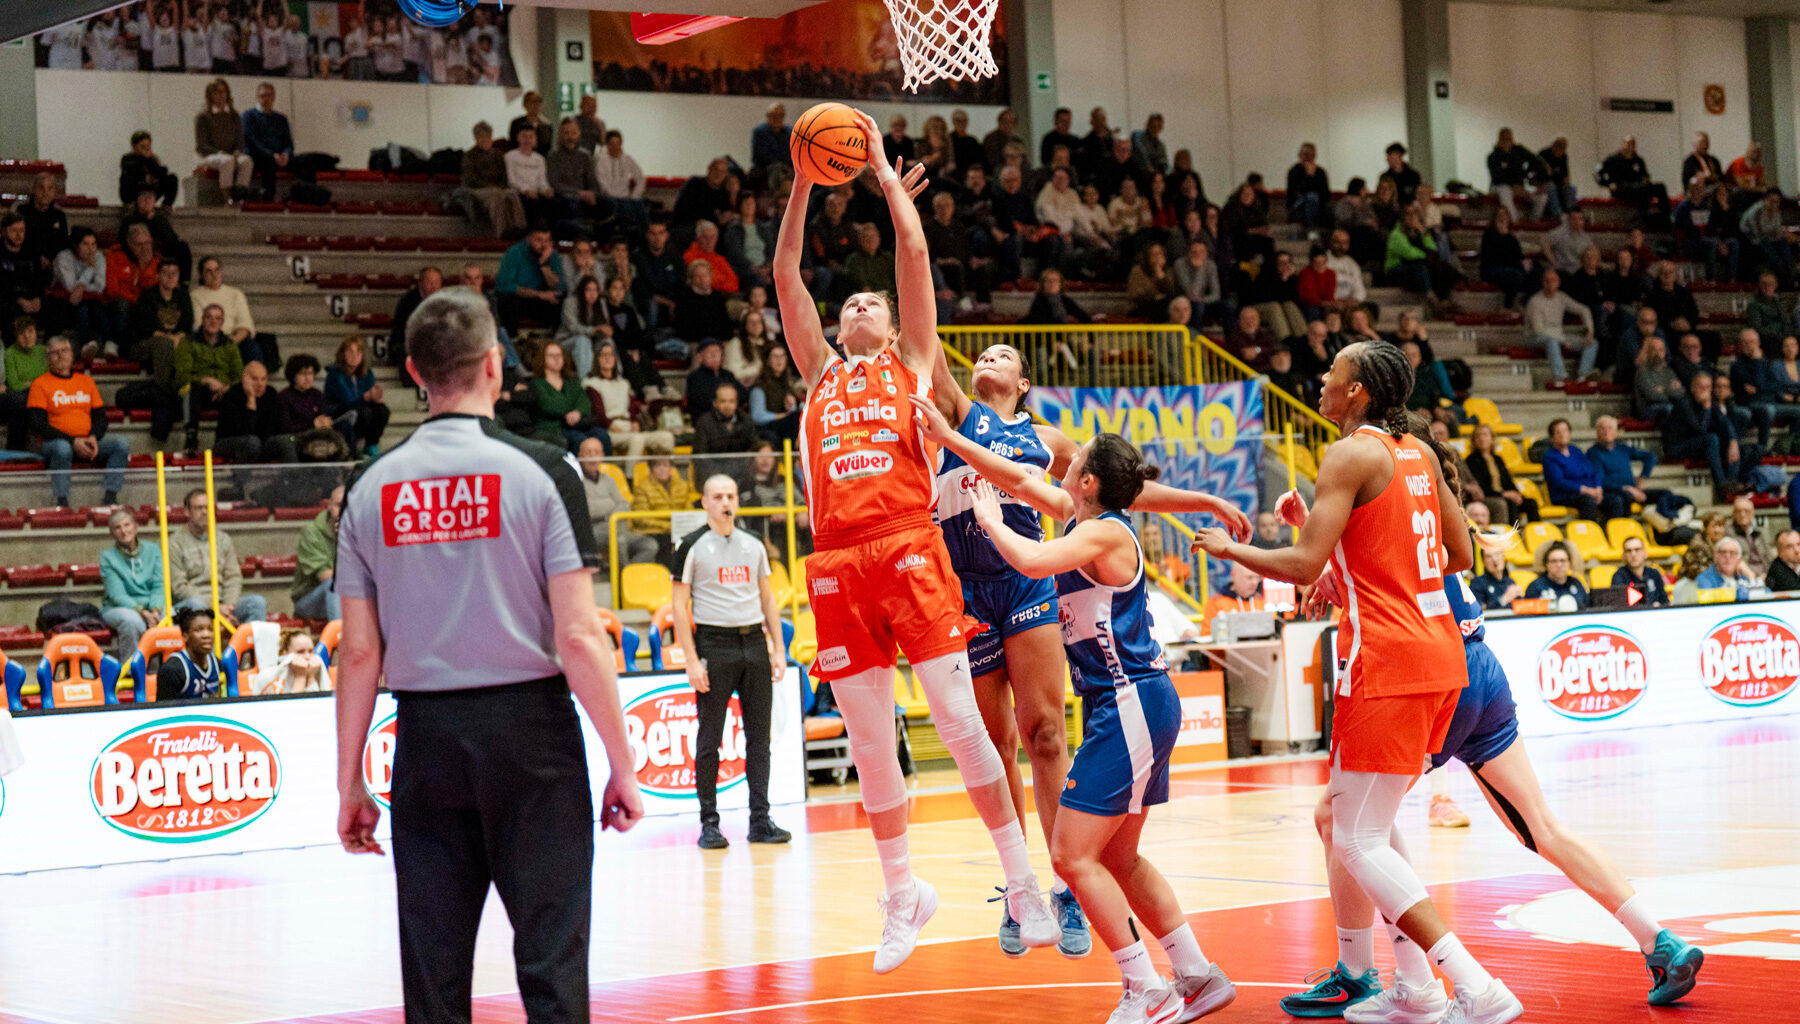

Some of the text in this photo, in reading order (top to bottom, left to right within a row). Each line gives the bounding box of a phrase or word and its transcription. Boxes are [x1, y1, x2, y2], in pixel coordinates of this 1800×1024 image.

[820, 398, 897, 434] famila
[975, 415, 990, 435] 5
[1060, 403, 1237, 457] HYPNO
[822, 436, 839, 448] HDI
[989, 440, 1014, 457] PB63
[834, 455, 889, 475] Wüber
[393, 475, 489, 512] ATTAL
[393, 505, 489, 533] GROUP
[894, 553, 927, 571] VALMORA
[1011, 606, 1040, 625] PB63
[1728, 624, 1769, 643] Fratelli
[1568, 635, 1611, 655] Fratelli
[1702, 633, 1800, 687] Beretta
[1542, 645, 1646, 701] Beretta
[1740, 681, 1769, 698] 1812
[1580, 695, 1610, 712] 1812
[1180, 709, 1222, 732] amila
[147, 731, 219, 756] Fratelli
[100, 742, 275, 817] Beretta
[164, 807, 215, 829] 1812
